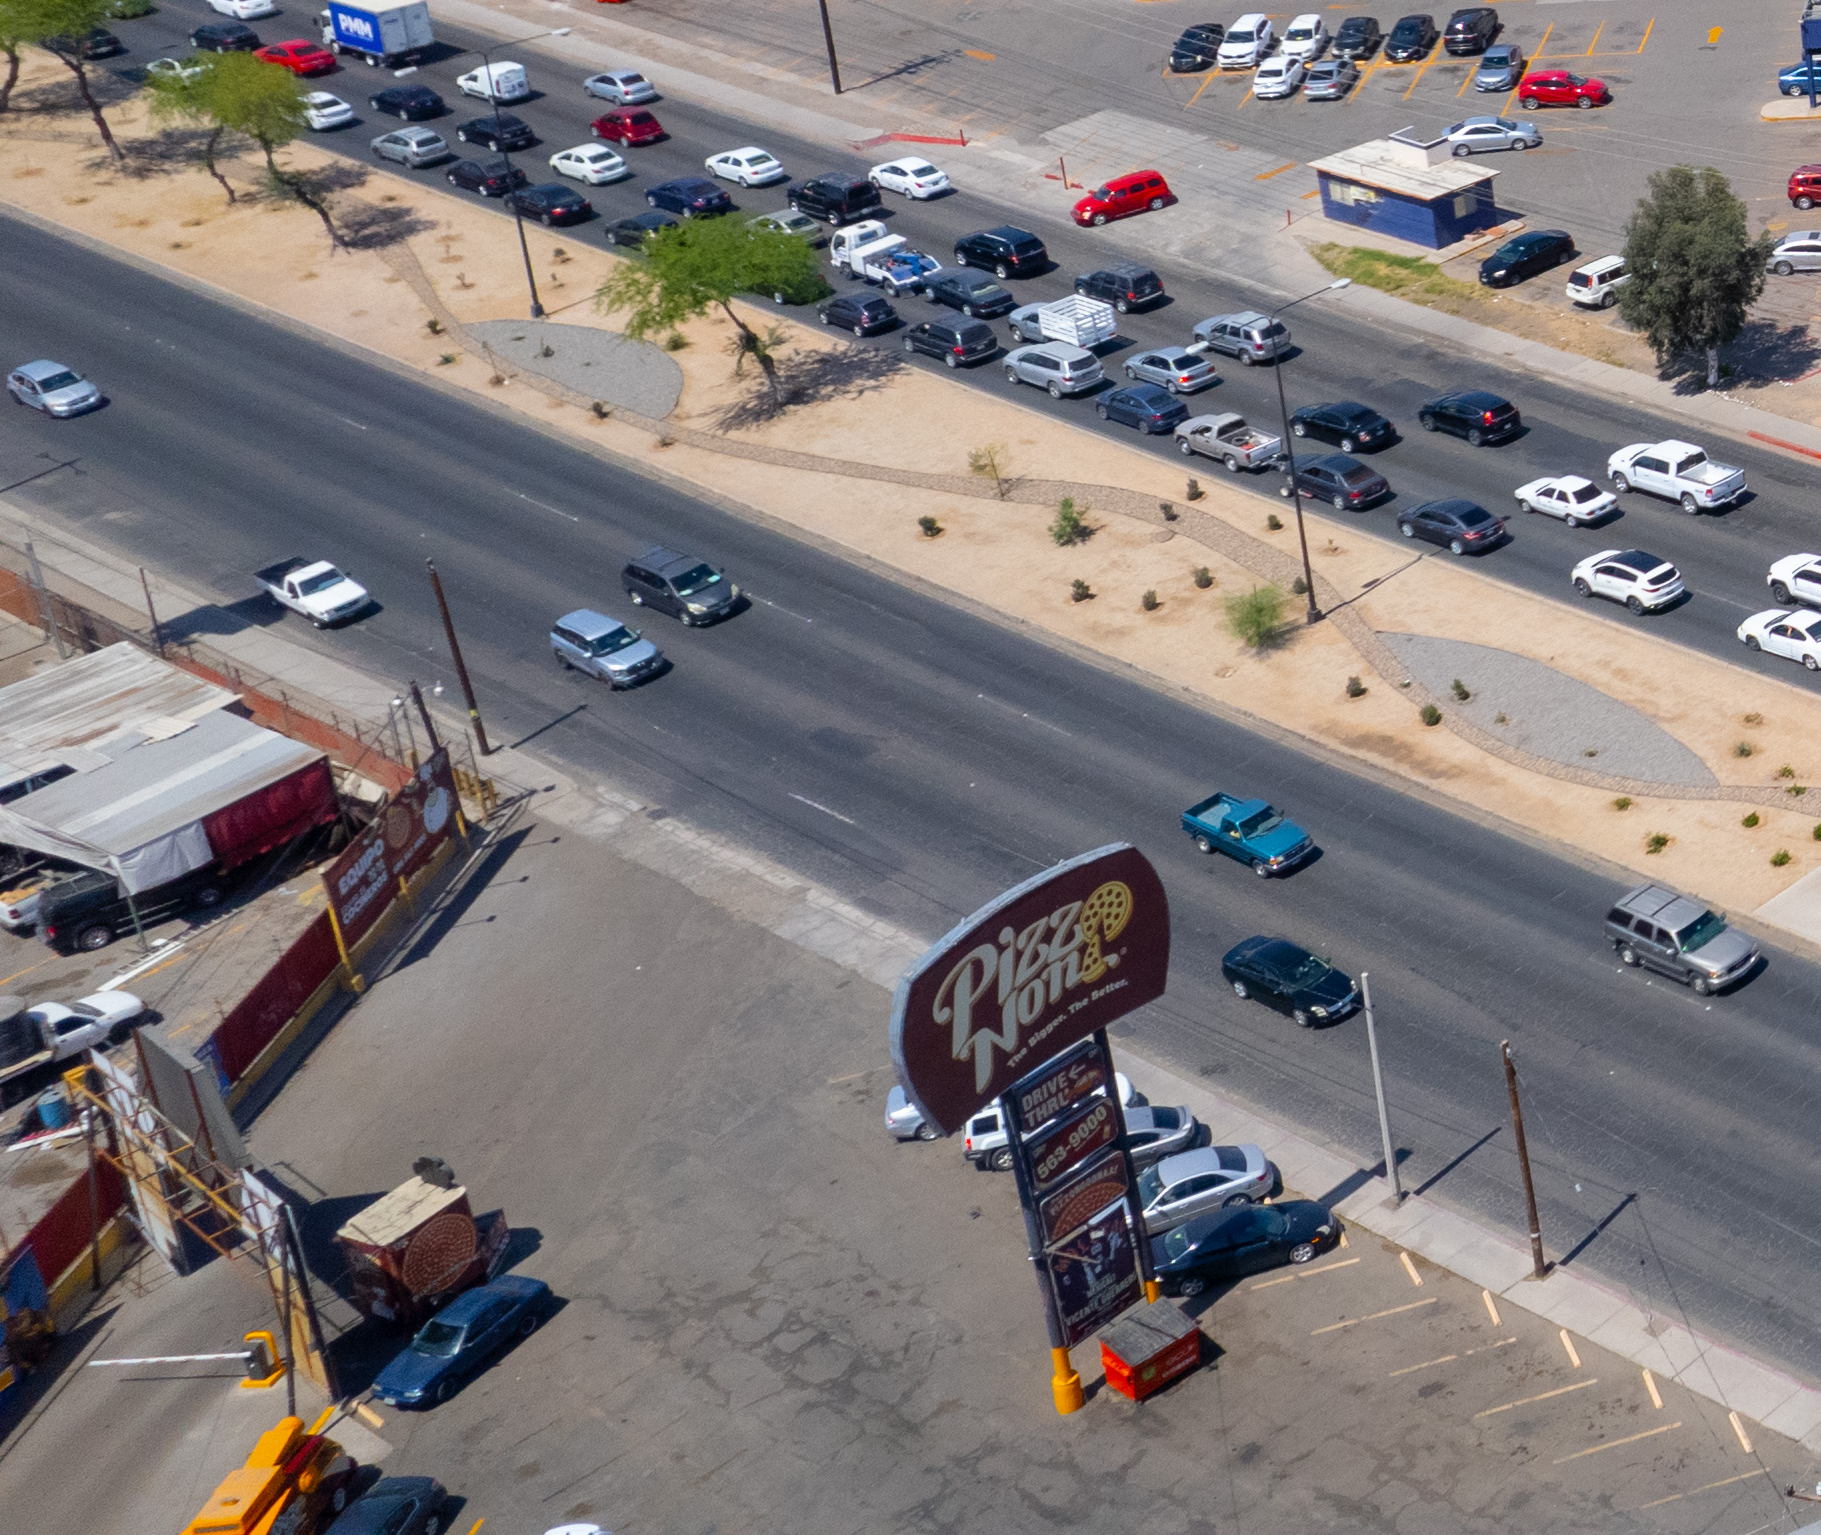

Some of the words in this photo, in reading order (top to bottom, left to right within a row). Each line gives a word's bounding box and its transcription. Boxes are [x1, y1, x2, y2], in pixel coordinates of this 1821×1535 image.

[338, 13, 373, 39] PMM
[338, 838, 385, 896] EQUIPO
[1006, 1047, 1028, 1068] The
[1028, 1014, 1067, 1047] Bigger.
[1067, 997, 1089, 1014] The
[1091, 978, 1128, 1001] Better.
[1021, 1071, 1069, 1113] DRIVE
[1036, 1105, 1108, 1179] 563-9000
